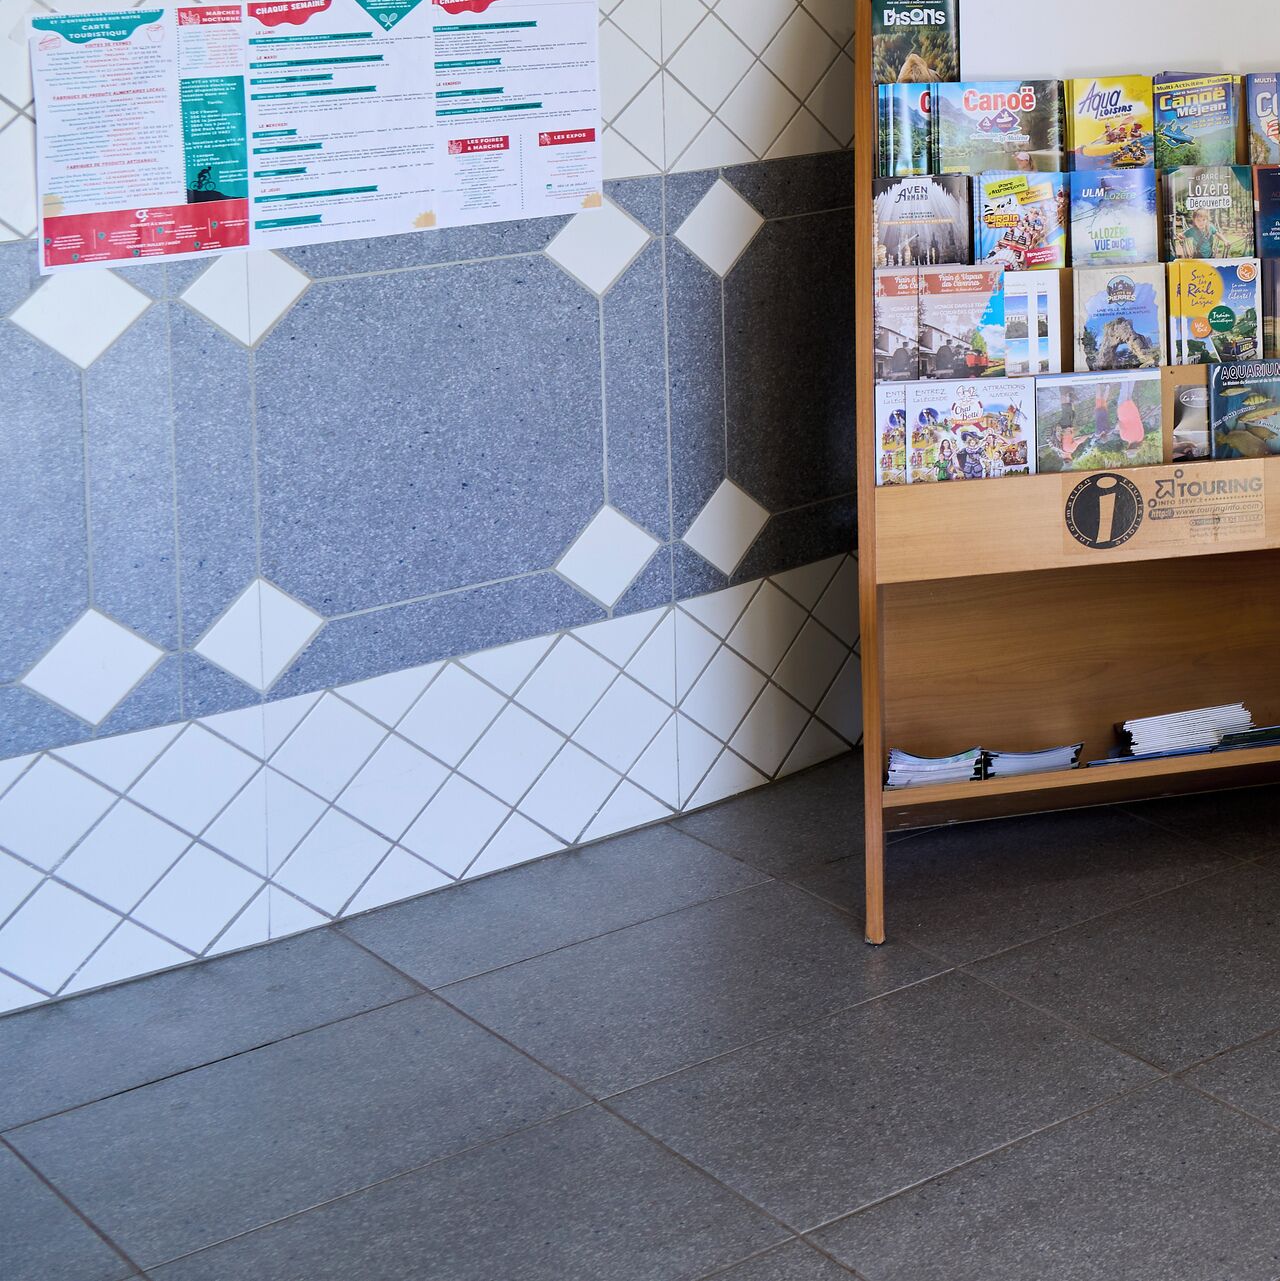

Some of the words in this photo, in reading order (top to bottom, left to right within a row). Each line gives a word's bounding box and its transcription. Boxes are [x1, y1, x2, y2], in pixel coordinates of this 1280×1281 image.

[255, 3, 290, 15] CHAQUE
[290, 0, 326, 10] SEMAINE
[68, 29, 128, 39] TOURISTIQUE
[963, 87, 1036, 111] Canoë
[1078, 81, 1122, 120] Aqua
[1159, 87, 1225, 111] Canoë
[1100, 105, 1133, 117] LOISIRS
[1177, 101, 1227, 118] Méjean
[1201, 174, 1221, 183] PARC
[1082, 188, 1104, 198] ULM
[1188, 180, 1229, 198] Lozère
[1189, 198, 1231, 209] Découverte
[1187, 283, 1215, 296] Rails
[1178, 477, 1263, 498] TOURING
